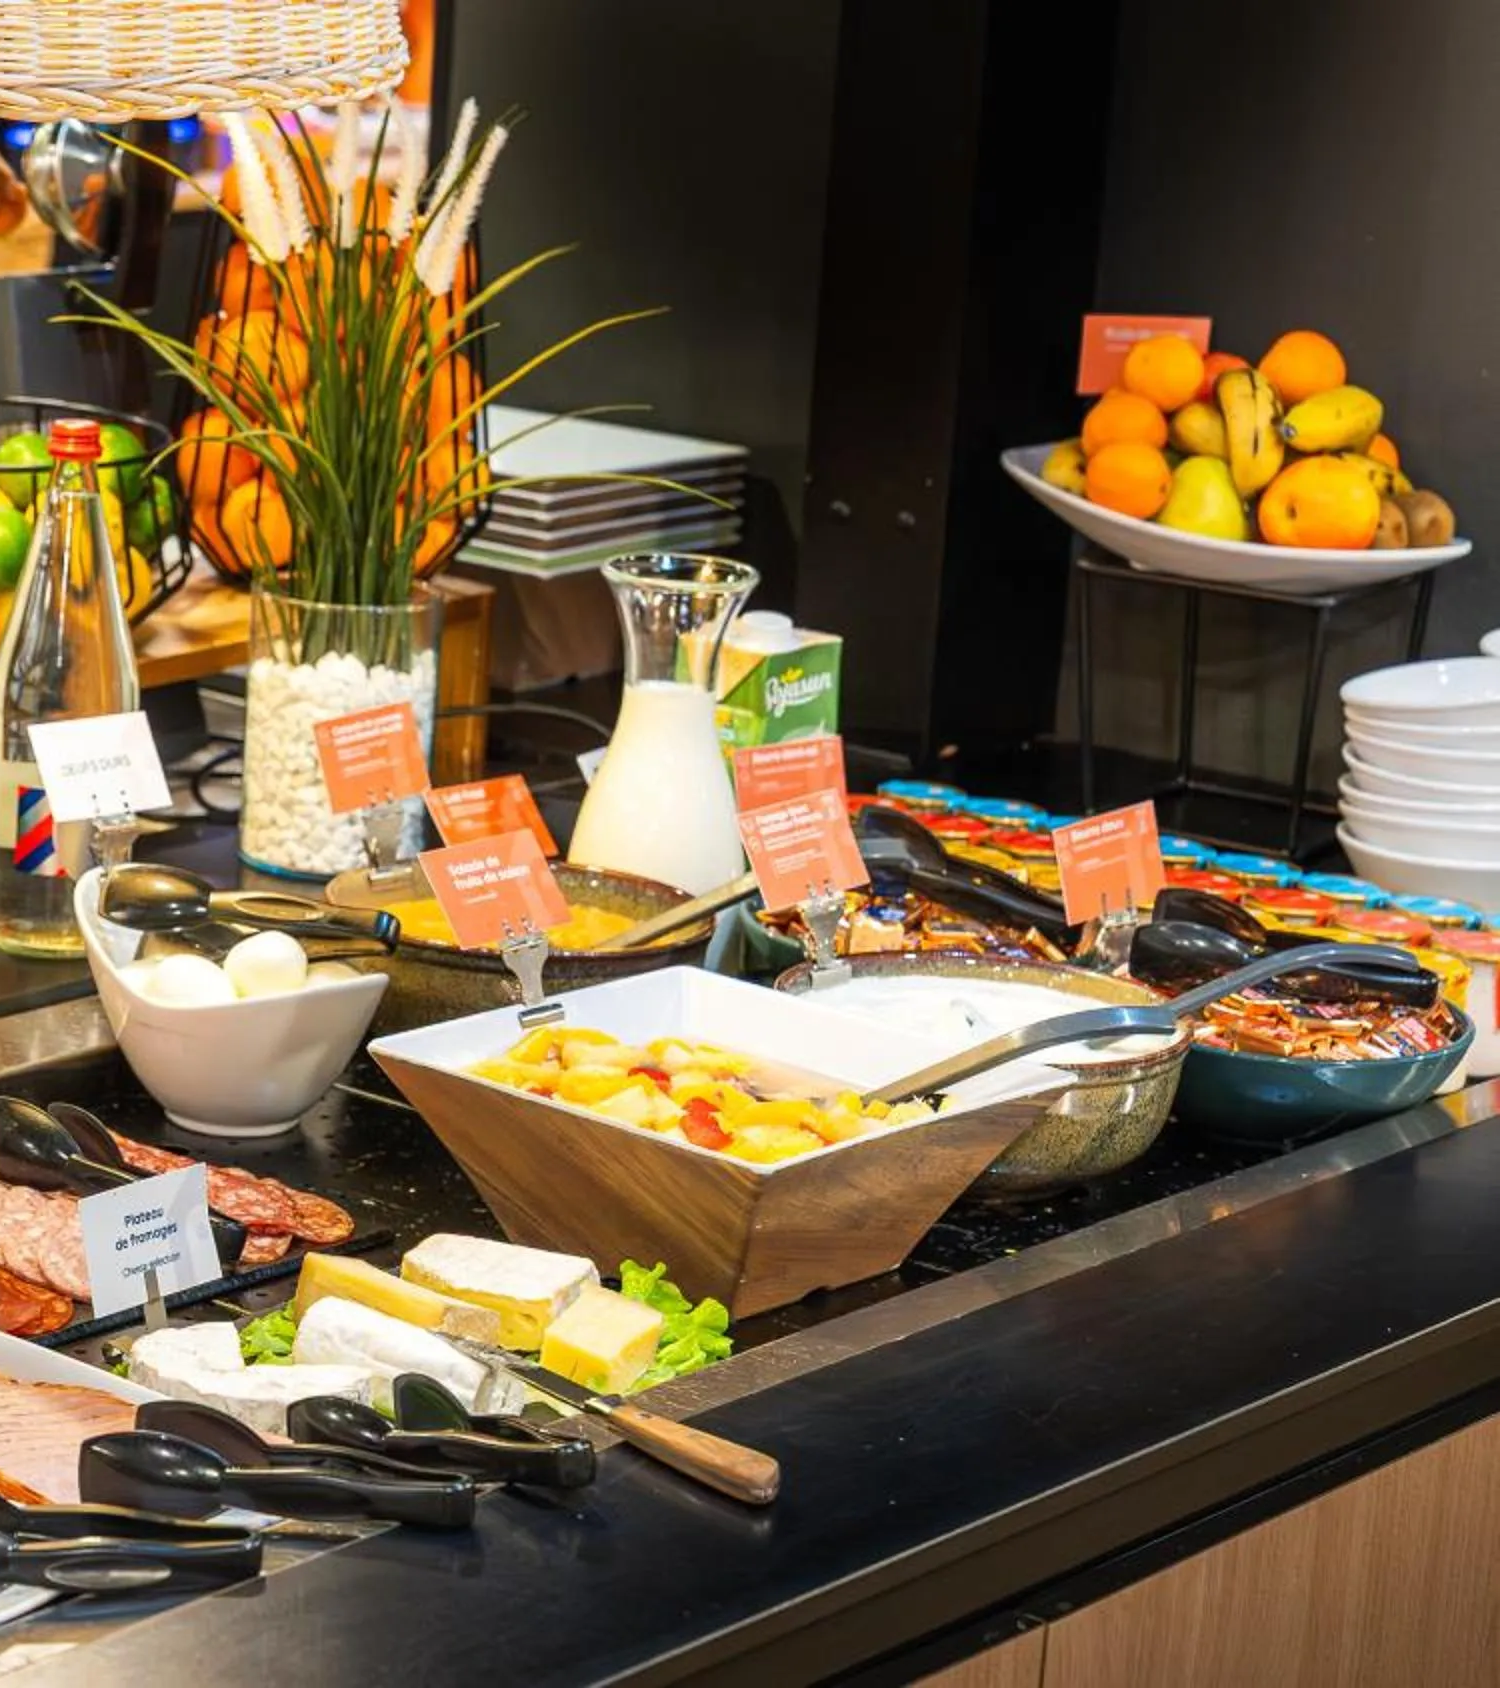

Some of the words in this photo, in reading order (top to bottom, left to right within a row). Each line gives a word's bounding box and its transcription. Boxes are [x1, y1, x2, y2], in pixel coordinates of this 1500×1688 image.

[124, 1206, 164, 1228] Plateau
[115, 1238, 129, 1251] de
[129, 1222, 178, 1246] fromages
